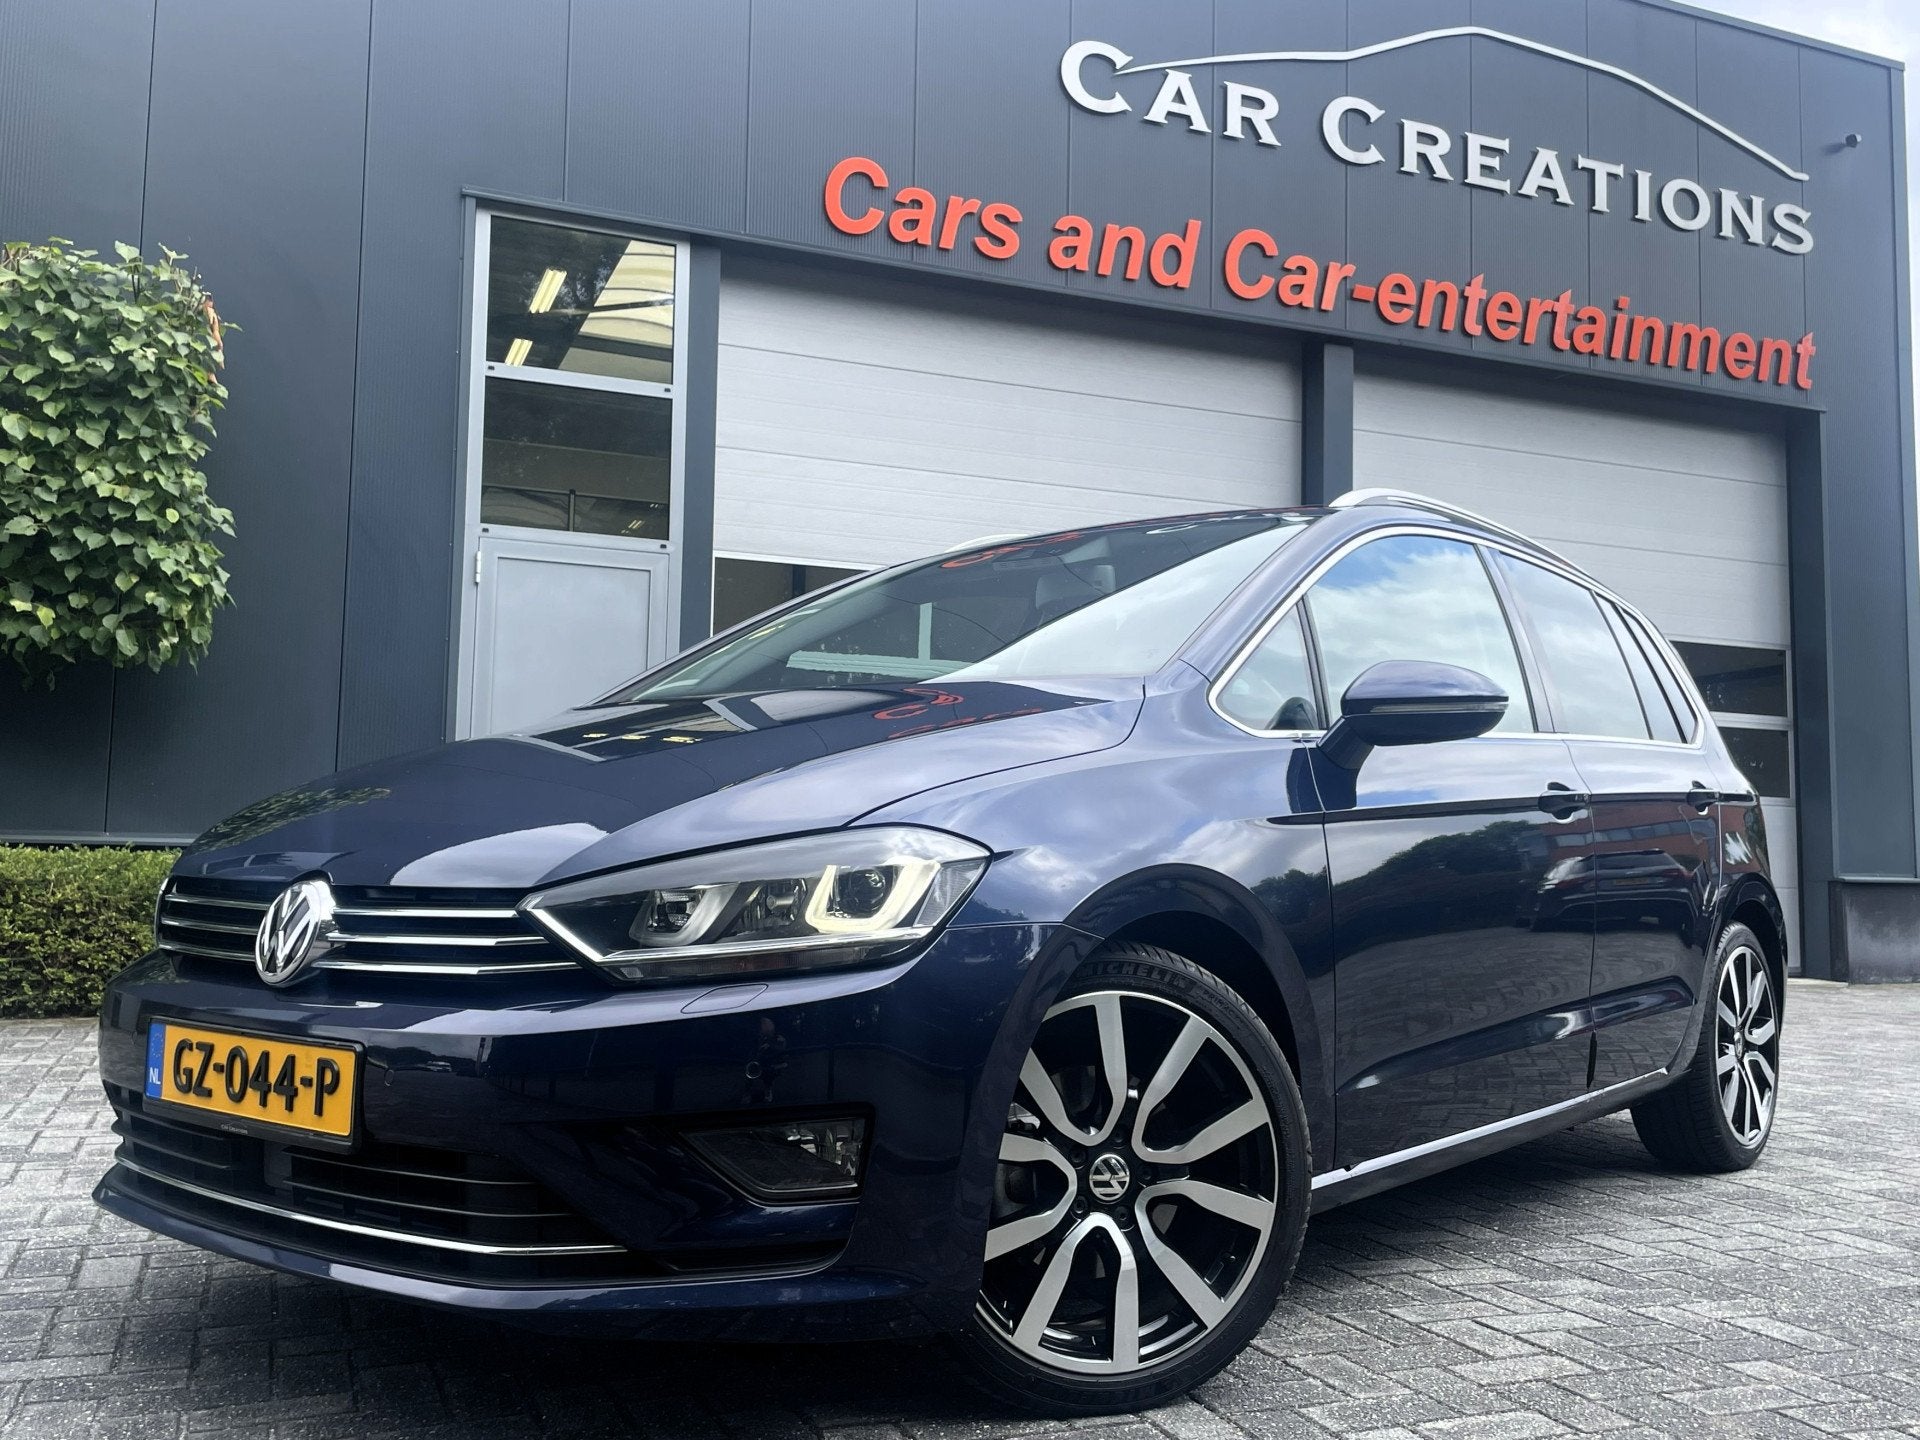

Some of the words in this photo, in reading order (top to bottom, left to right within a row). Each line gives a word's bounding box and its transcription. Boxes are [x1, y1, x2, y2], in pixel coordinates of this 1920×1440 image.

[1060, 40, 1282, 148] CAR
[1321, 95, 1815, 256] CREATIONS
[824, 157, 1022, 260] Cars
[1049, 215, 1201, 290] and
[1224, 229, 1815, 390] Car-entertainment
[1075, 961, 1189, 990] MICHELIN
[149, 1066, 161, 1084] NL
[173, 1037, 341, 1117] GZ-044-P
